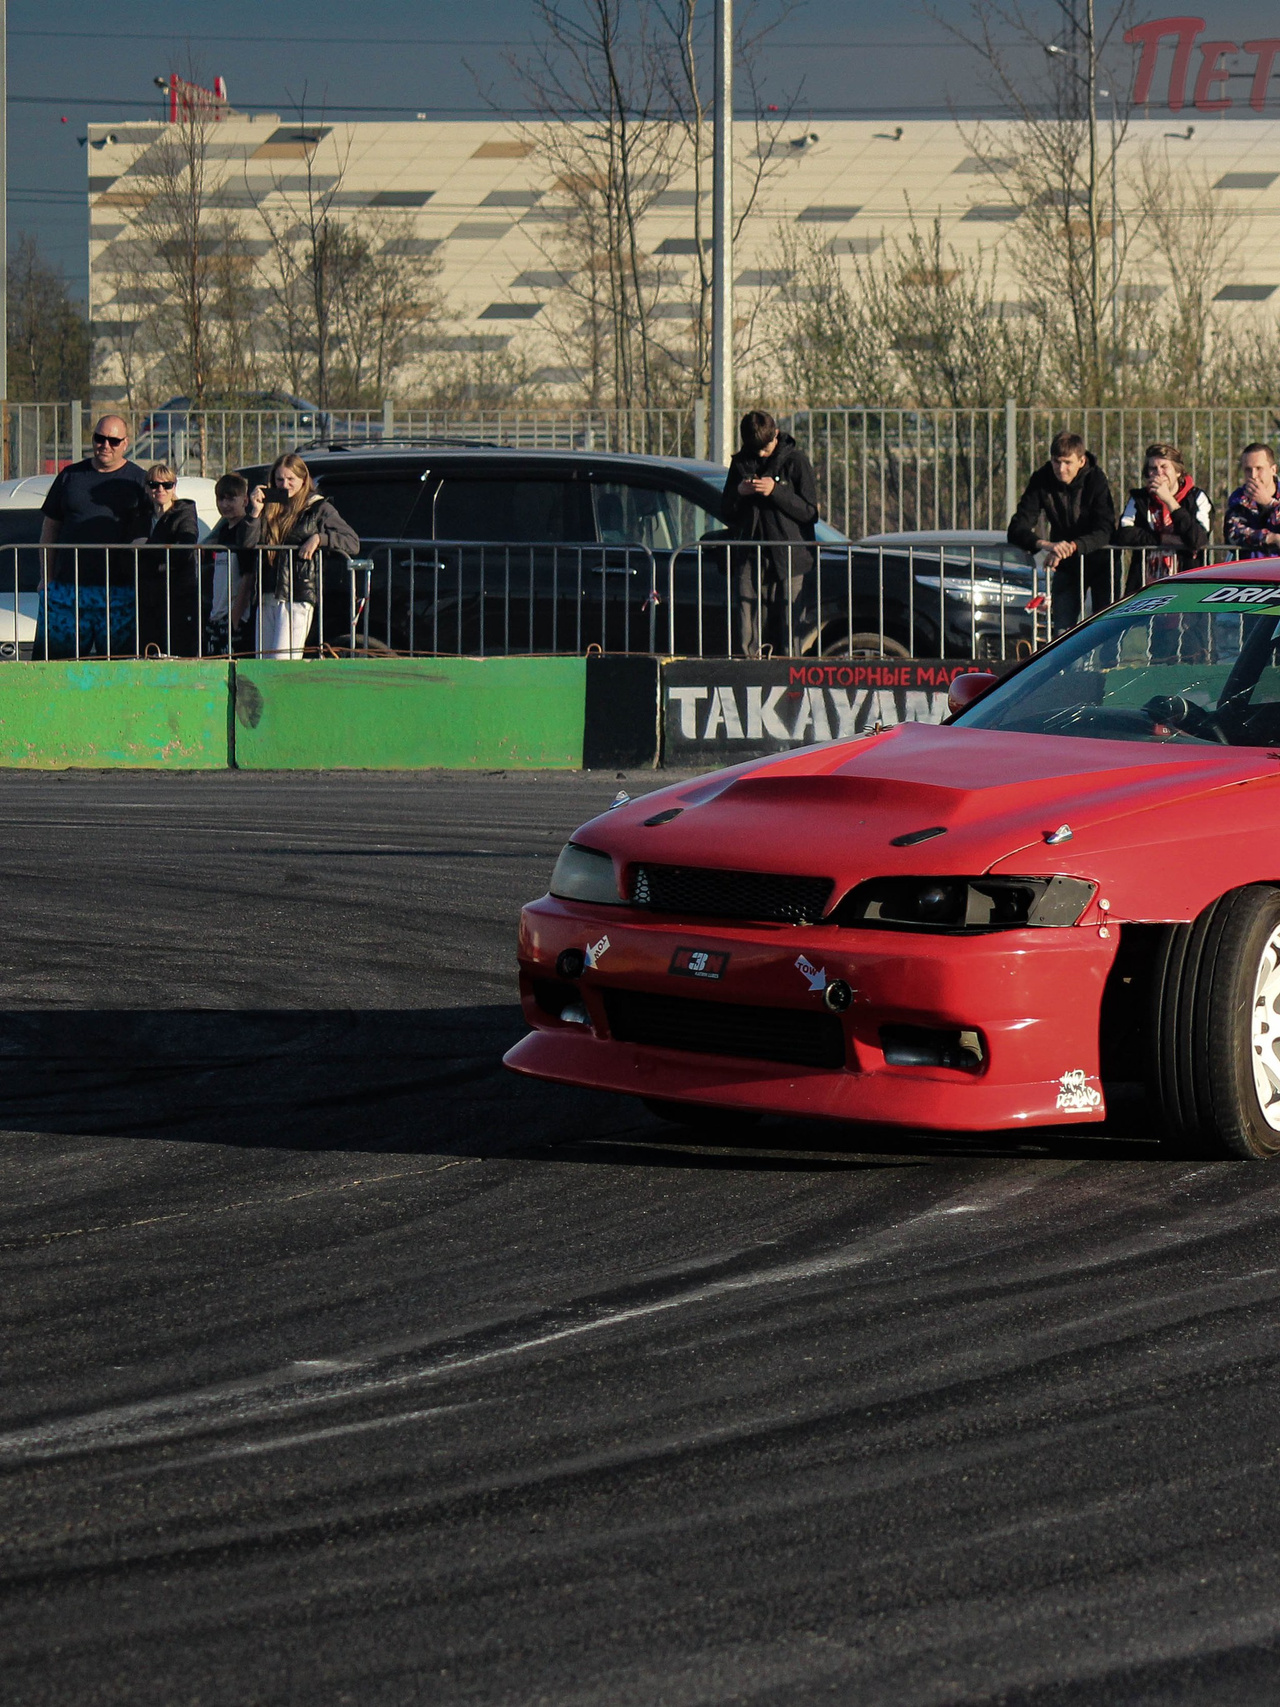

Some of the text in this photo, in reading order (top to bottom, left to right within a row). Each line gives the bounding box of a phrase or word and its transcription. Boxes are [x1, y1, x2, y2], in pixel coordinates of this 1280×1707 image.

[789, 666, 994, 687] МОТОРНЫЕ МАС
[669, 686, 952, 741] TAKAYAM
[593, 938, 607, 962] TOW
[797, 962, 819, 977] TOW
